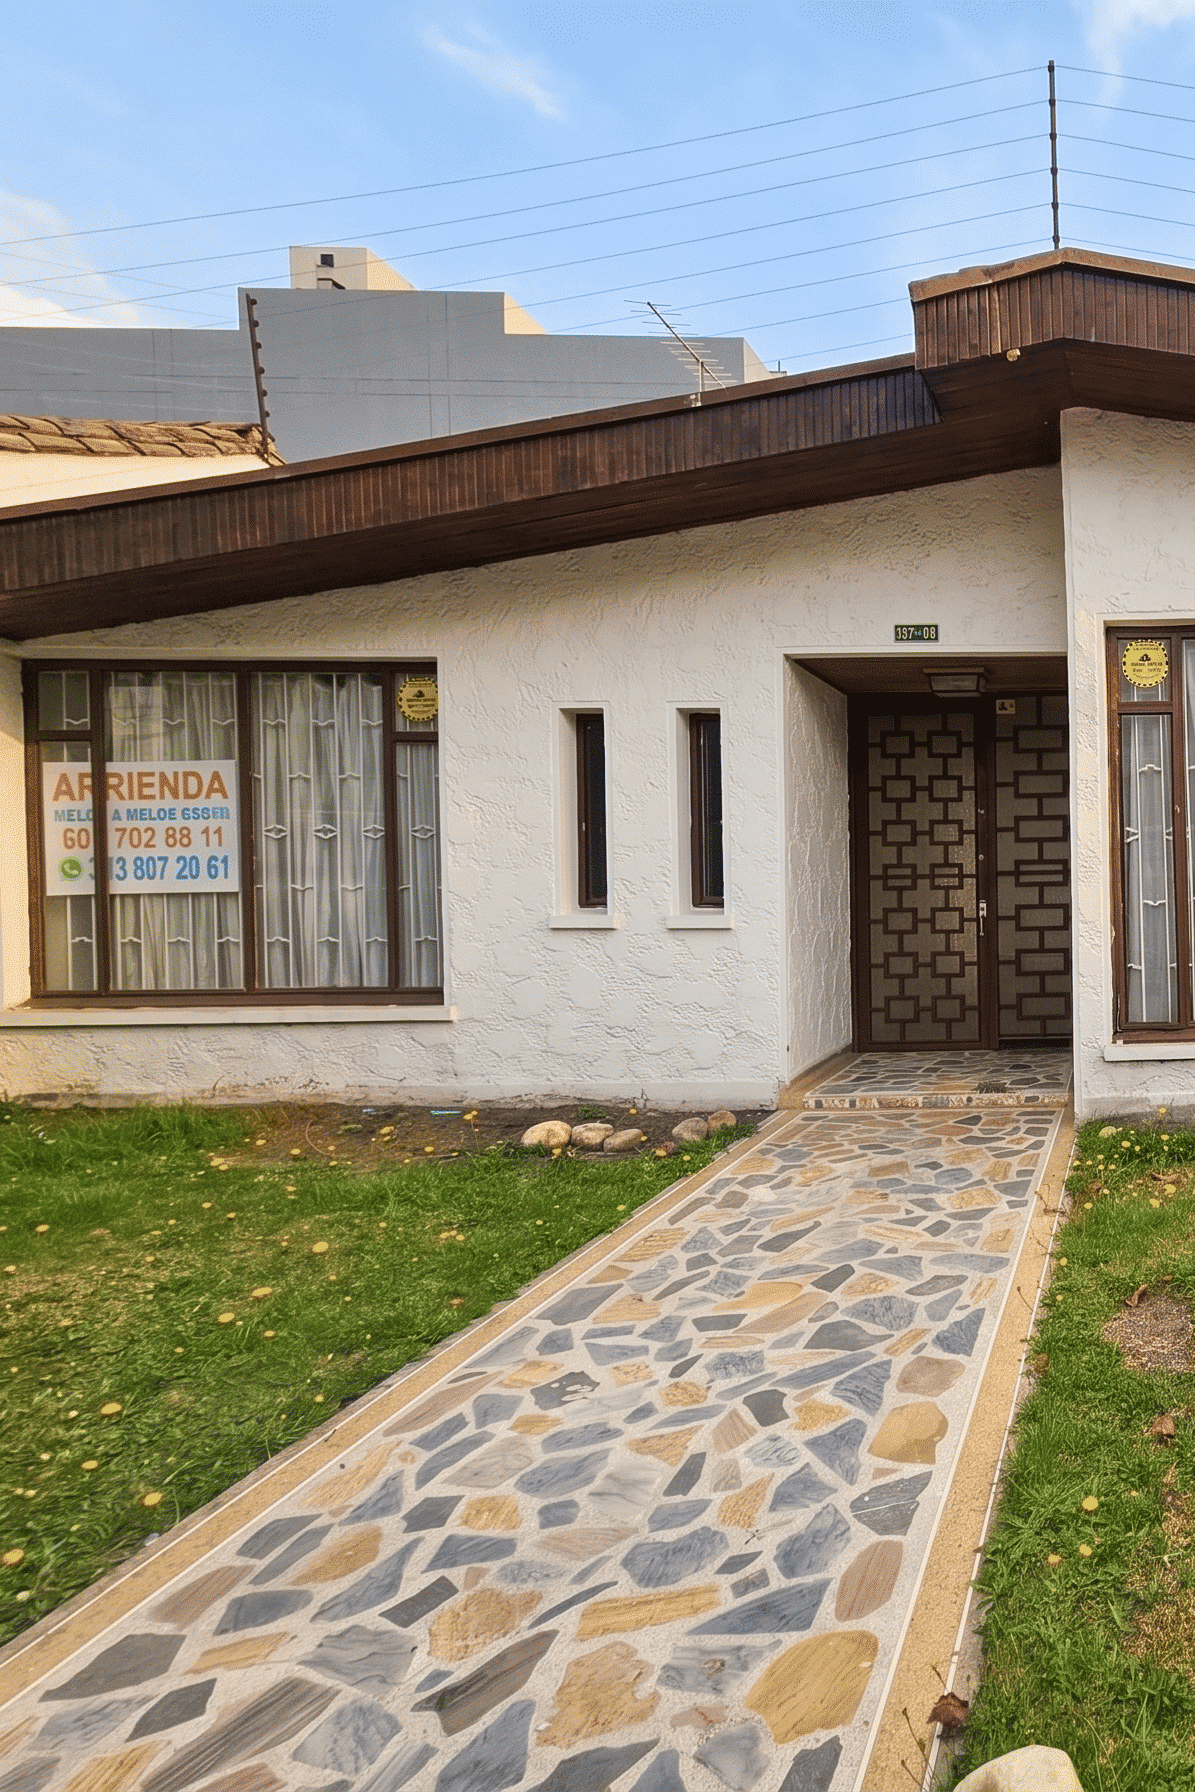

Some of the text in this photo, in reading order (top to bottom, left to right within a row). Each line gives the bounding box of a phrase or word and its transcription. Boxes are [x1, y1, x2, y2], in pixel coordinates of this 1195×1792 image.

[52, 770, 229, 802] ARRIENDA
[111, 809, 122, 822] A
[63, 826, 223, 850] 60 702 88 11
[133, 855, 169, 880] 807
[176, 855, 200, 880] 20
[207, 855, 229, 880] 61
